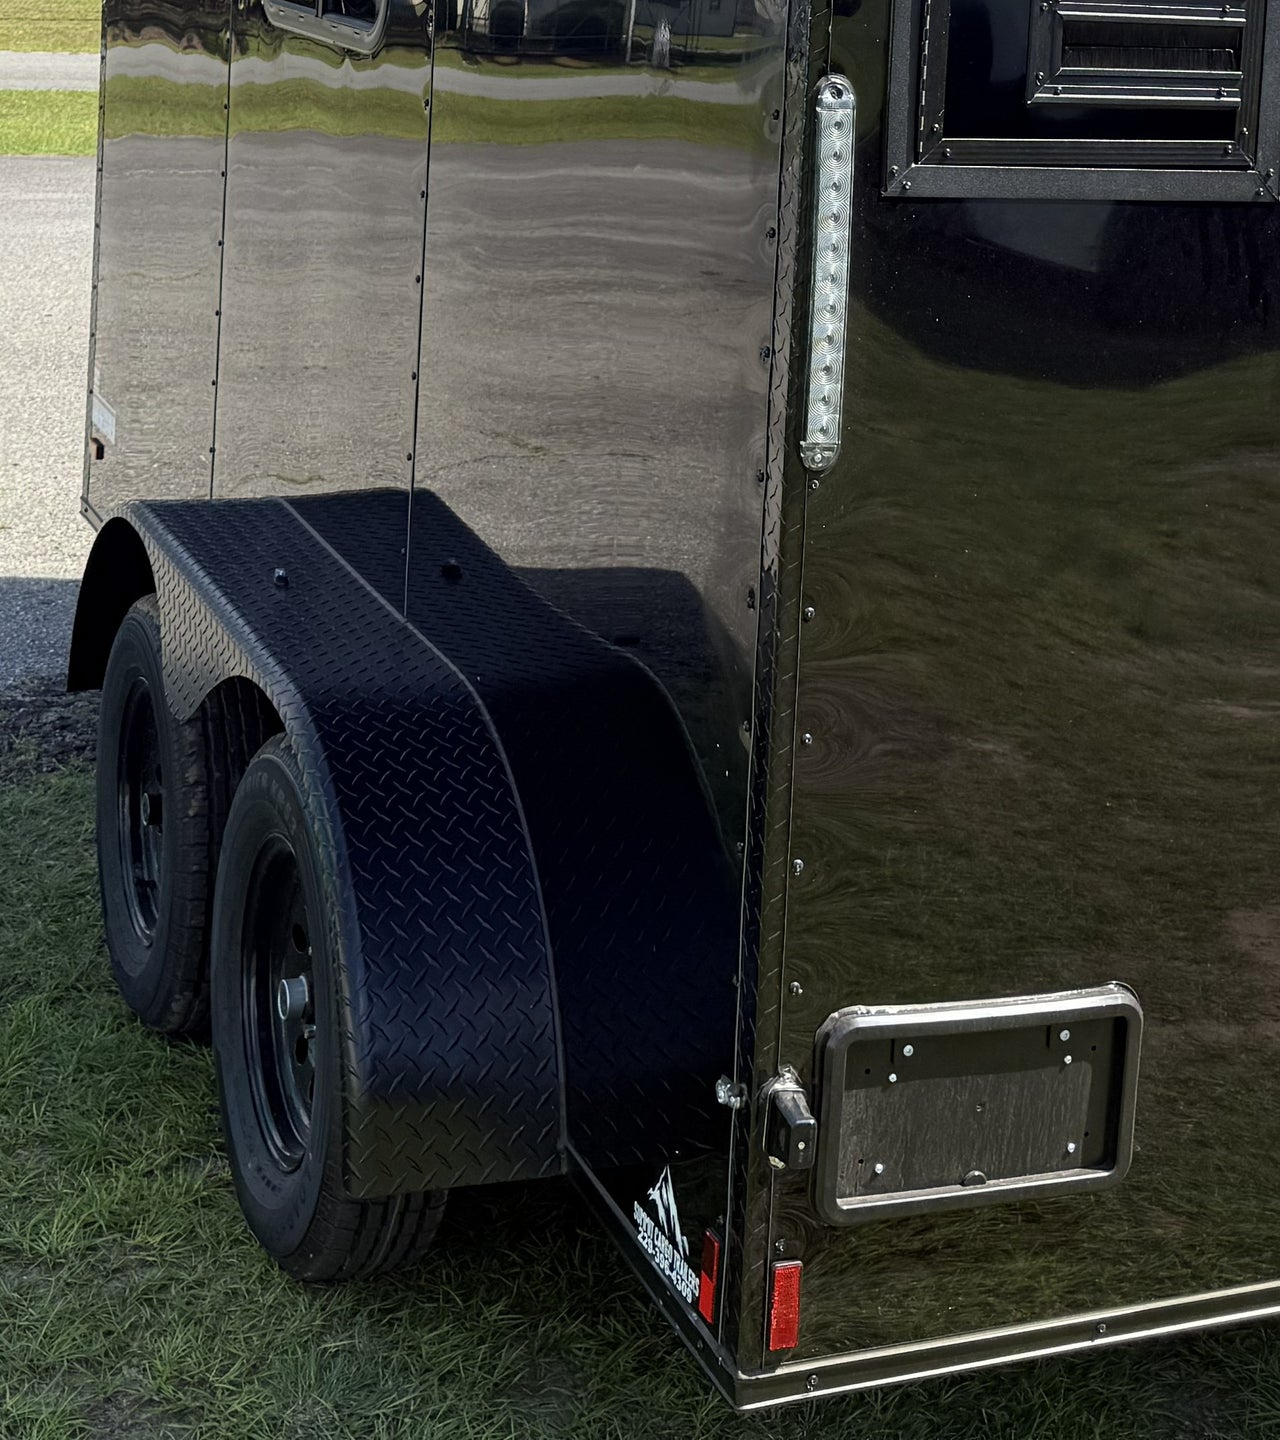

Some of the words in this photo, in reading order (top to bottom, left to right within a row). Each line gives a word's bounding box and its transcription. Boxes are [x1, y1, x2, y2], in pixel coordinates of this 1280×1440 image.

[637, 1226, 693, 1303] 229-396-4309
[654, 1226, 673, 1263] CARGO
[673, 1249, 700, 1297] TRAILERS
